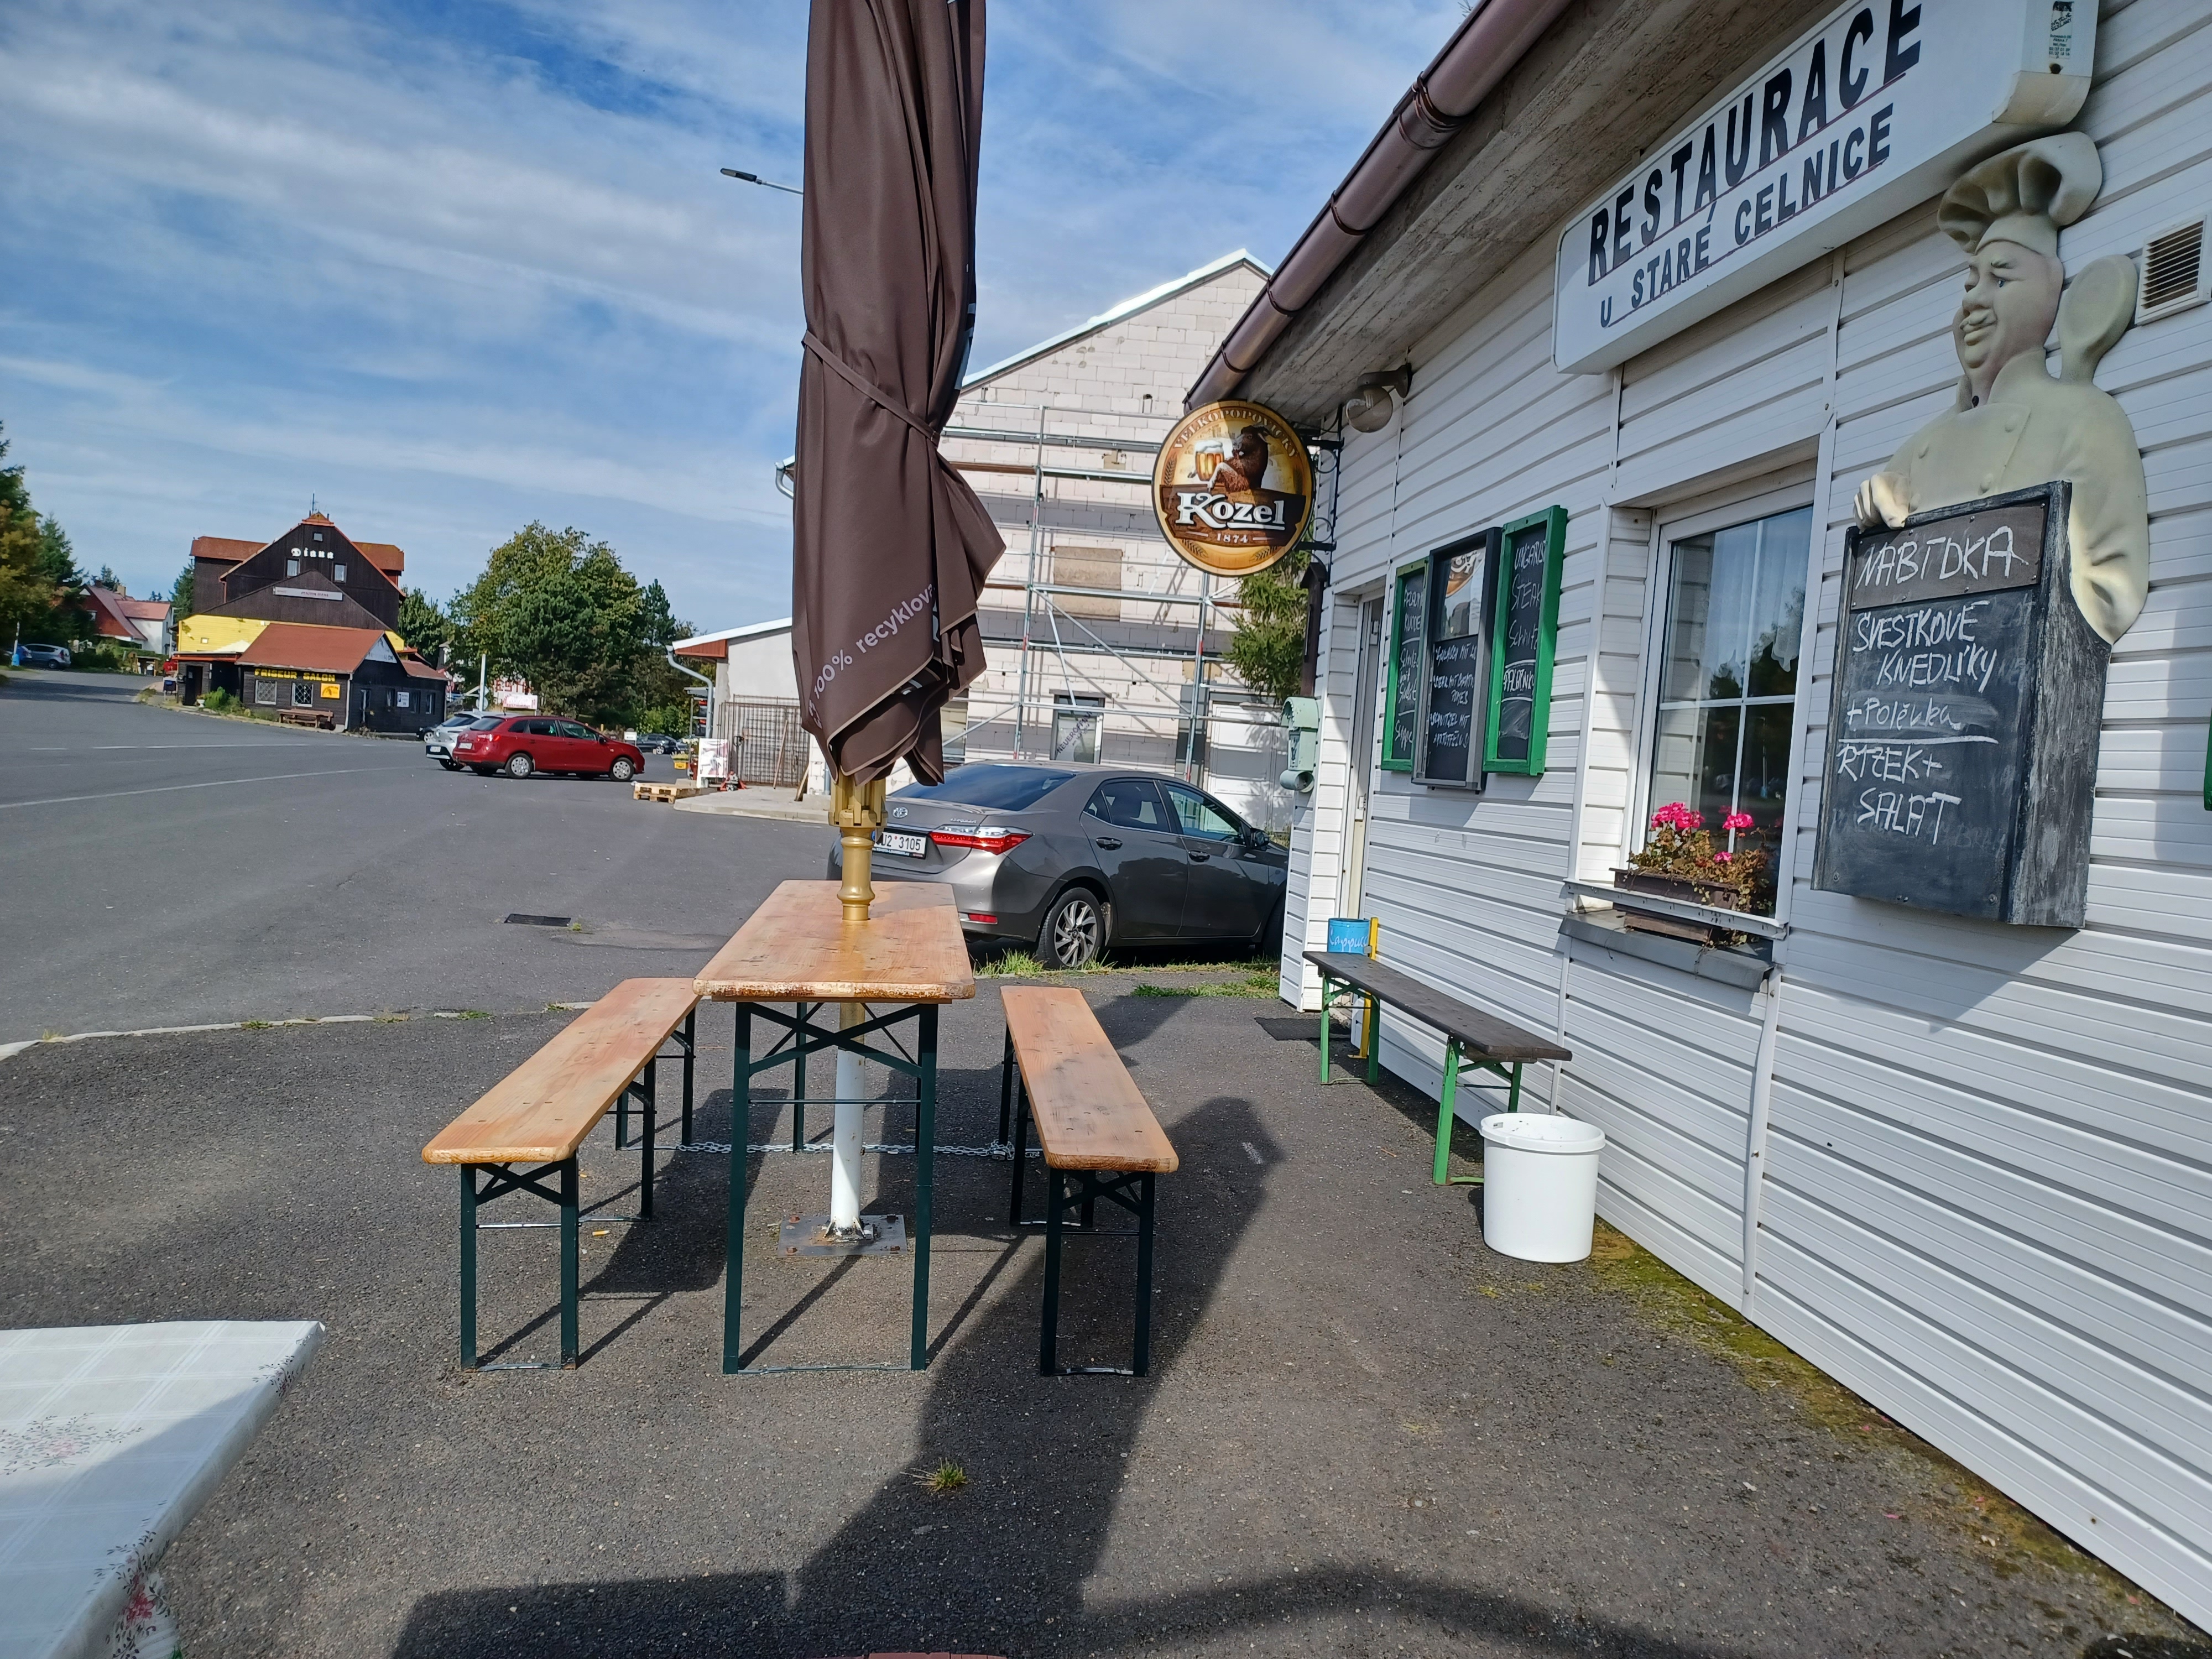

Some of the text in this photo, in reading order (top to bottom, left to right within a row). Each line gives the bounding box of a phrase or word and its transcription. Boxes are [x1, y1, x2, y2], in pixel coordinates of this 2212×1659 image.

[1587, 0, 1922, 286] RESTAURACE
[1599, 103, 1894, 328] U STARÉ CELNICE
[1175, 492, 1285, 529] Kozel
[1217, 533, 1249, 544] 1874
[254, 668, 336, 682] FRISEUR SALON
[814, 649, 853, 700] 100%
[1876, 643, 1997, 693] KNEDLÍKY
[899, 837, 921, 851] 3105
